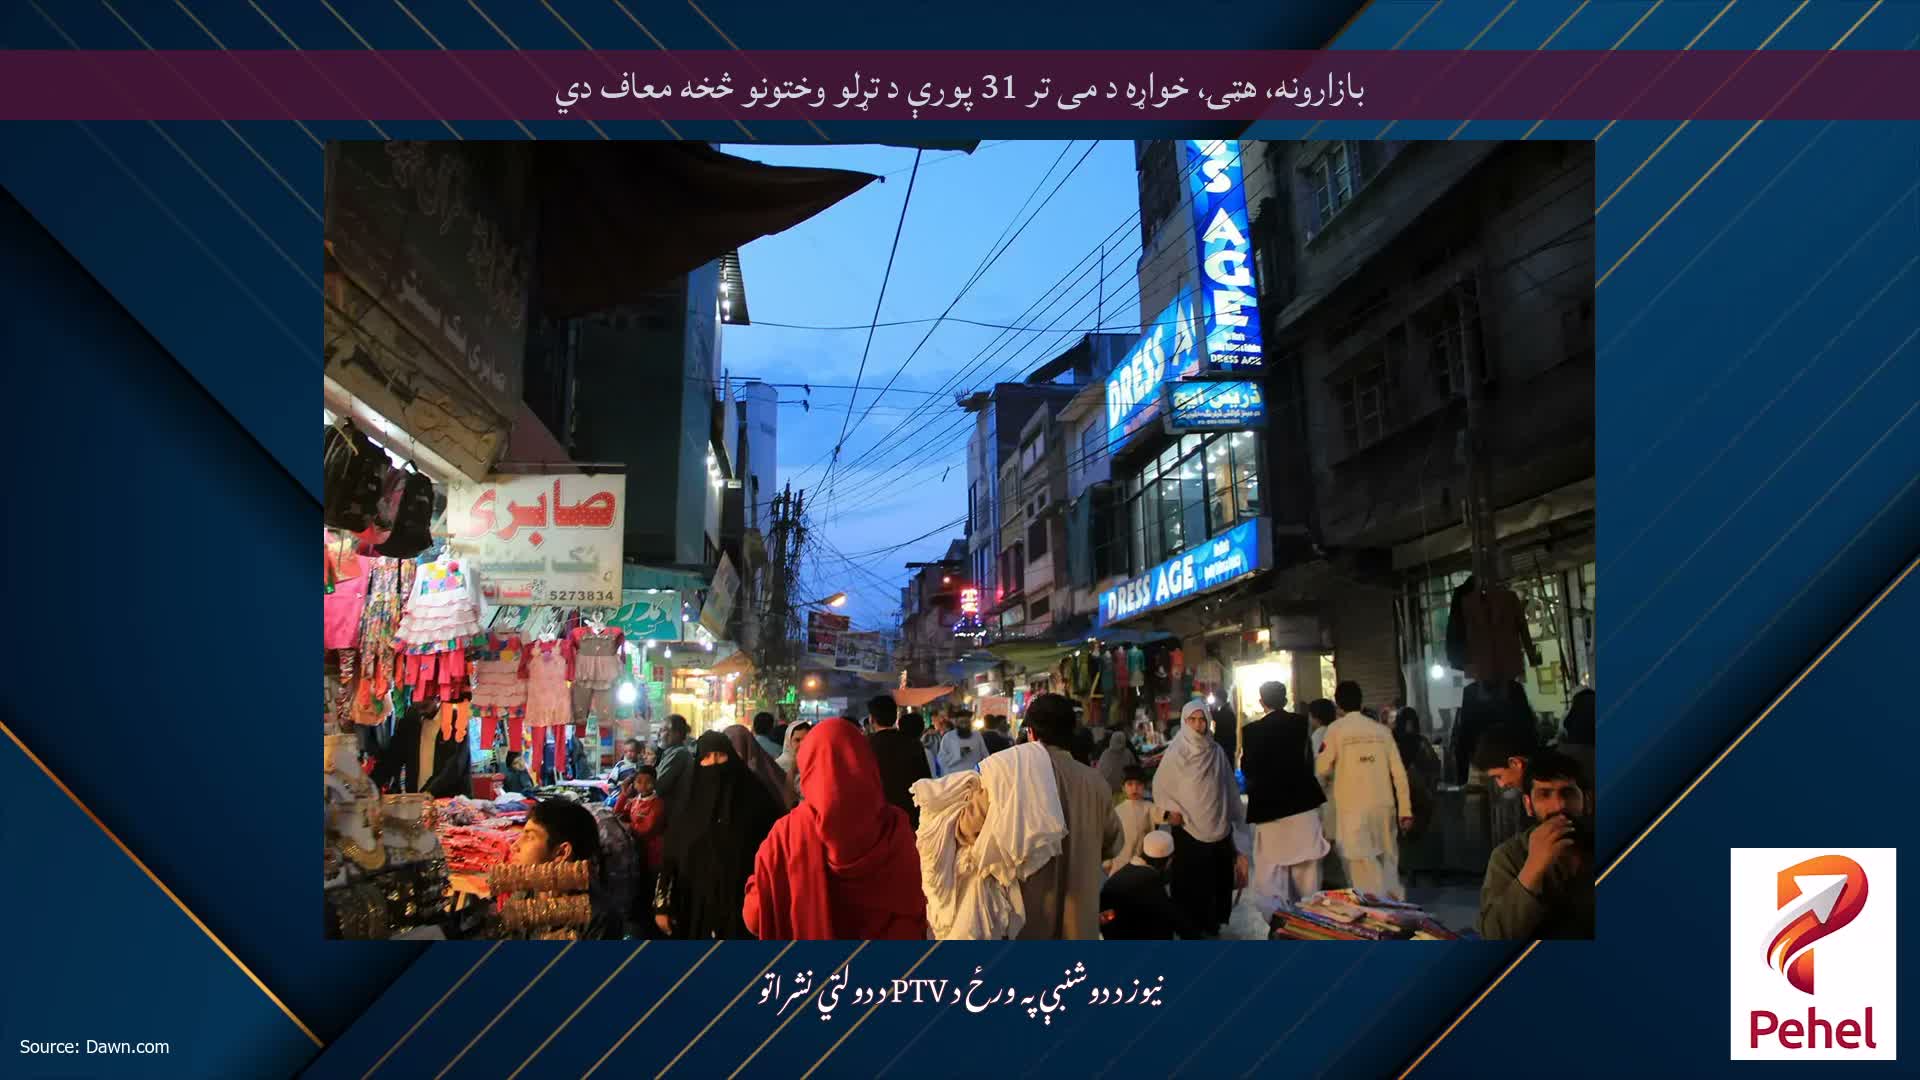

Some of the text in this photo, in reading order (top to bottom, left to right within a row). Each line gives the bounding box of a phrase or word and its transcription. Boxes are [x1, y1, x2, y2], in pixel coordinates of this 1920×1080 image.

[1203, 207, 1257, 328] AGE
[1108, 325, 1165, 431] DRESS
[1171, 302, 1197, 366] A
[460, 478, 616, 546] صابری
[549, 590, 614, 602] 5273834
[1107, 573, 1151, 621] DRESS
[1155, 553, 1196, 603] AGE
